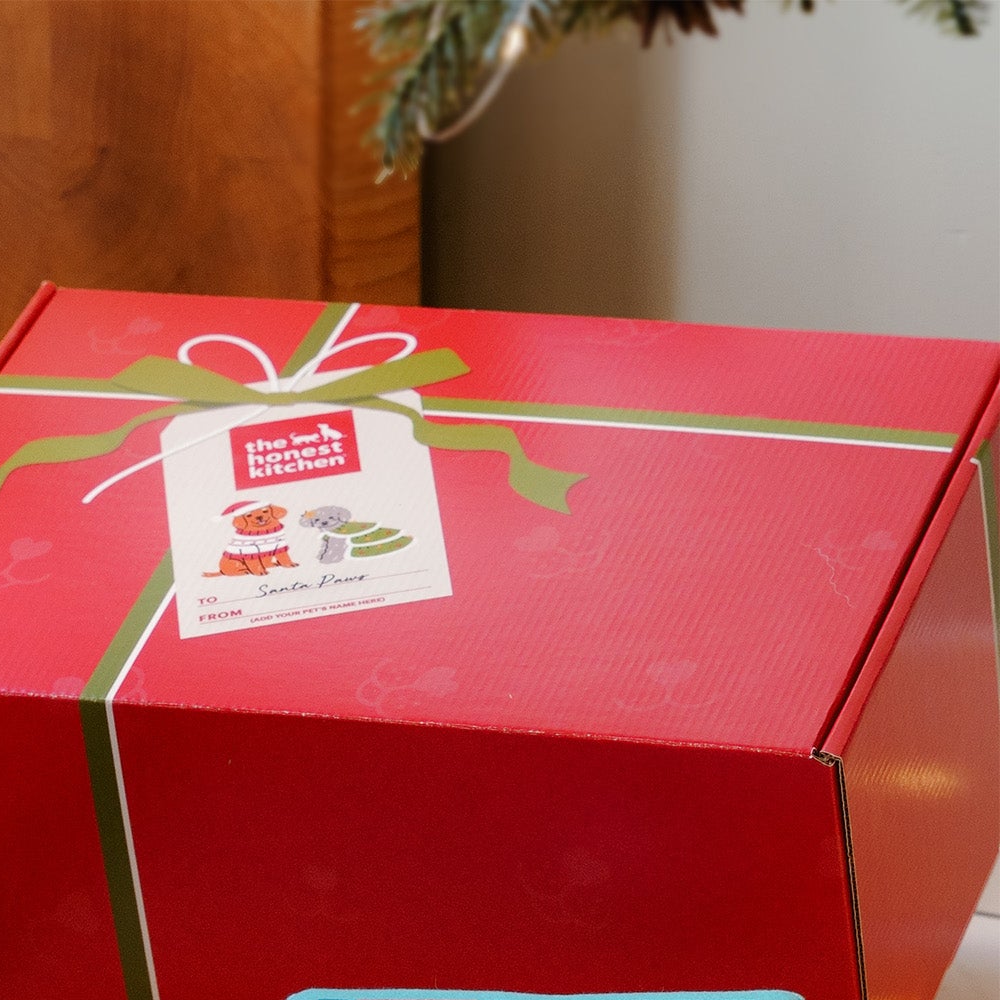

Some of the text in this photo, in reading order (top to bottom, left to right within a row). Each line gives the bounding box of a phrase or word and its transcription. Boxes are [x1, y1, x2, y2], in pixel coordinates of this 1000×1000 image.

[244, 438, 288, 453] the
[247, 441, 343, 466] honest
[249, 455, 346, 479] kitchen
[198, 574, 369, 606] TO Santa Paws
[199, 608, 242, 622] FROM
[275, 612, 301, 620] YOUR
[329, 602, 357, 610] NAME
